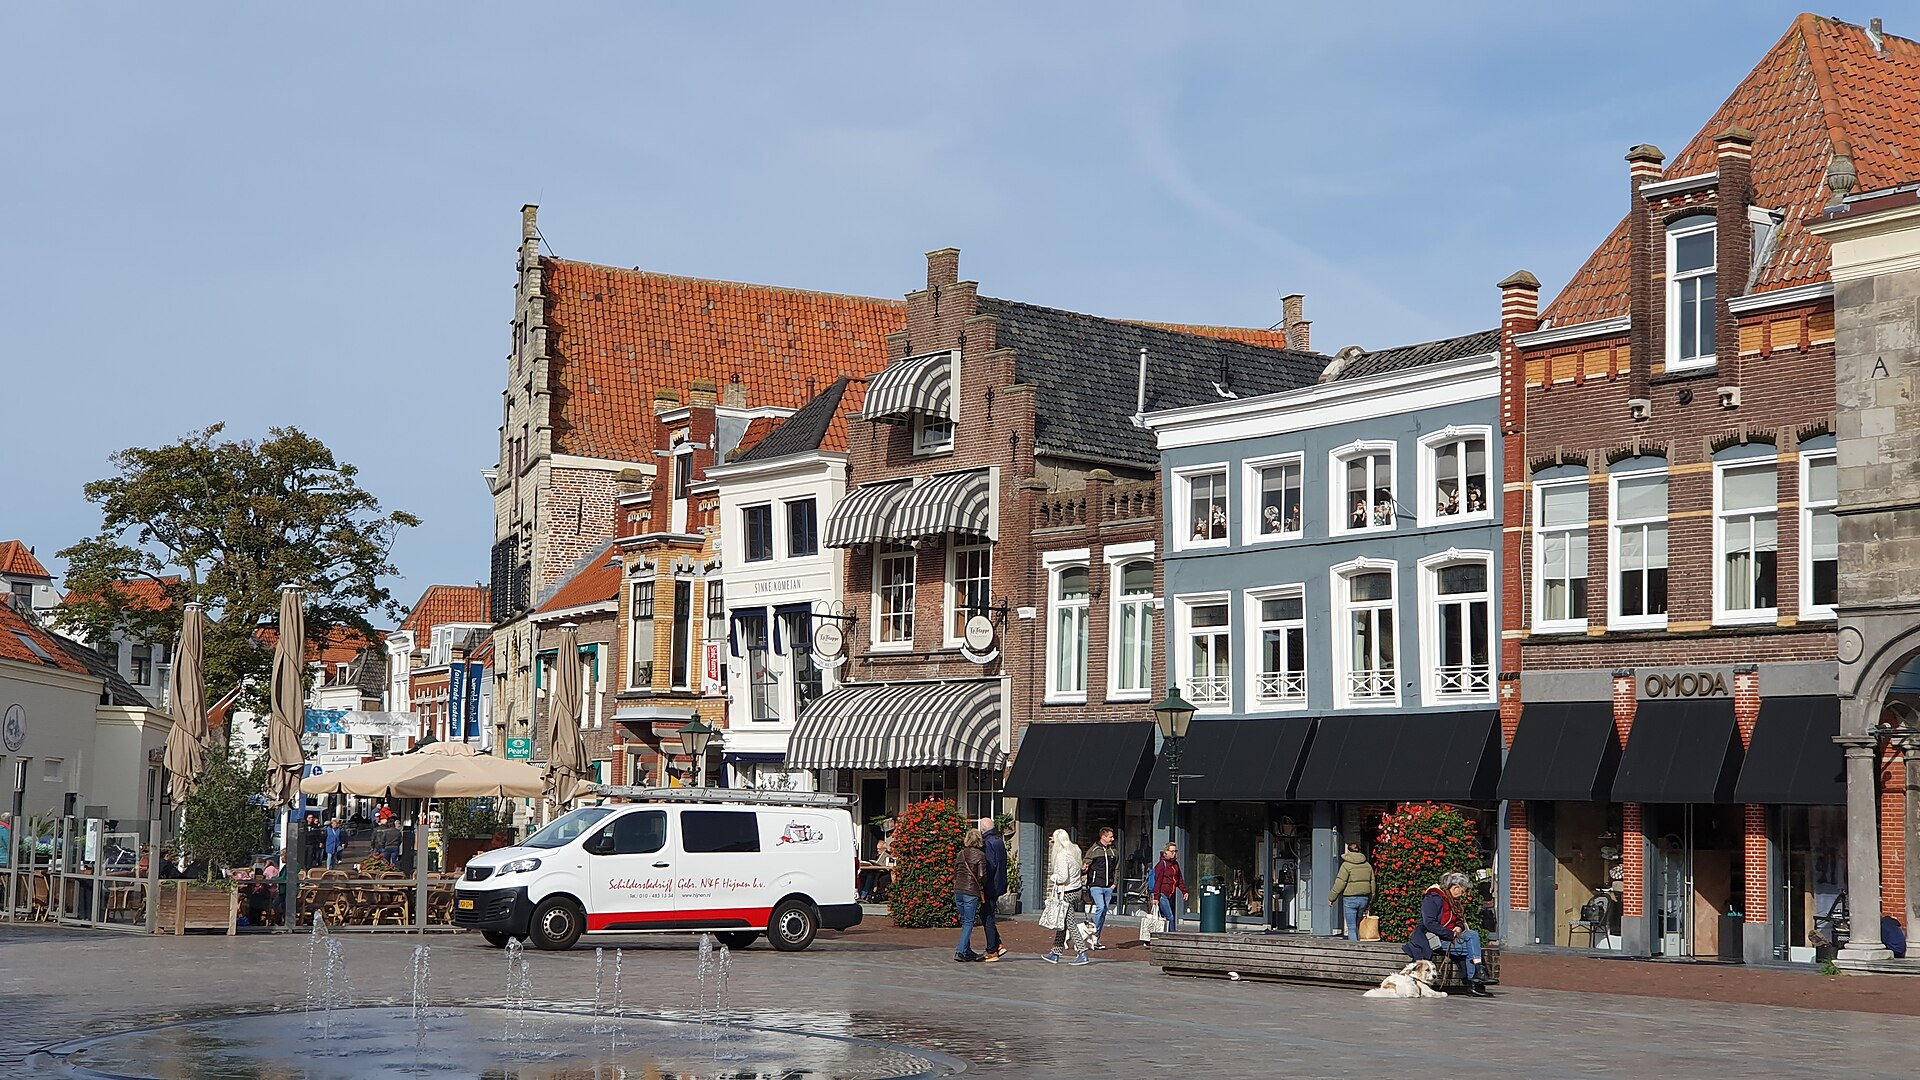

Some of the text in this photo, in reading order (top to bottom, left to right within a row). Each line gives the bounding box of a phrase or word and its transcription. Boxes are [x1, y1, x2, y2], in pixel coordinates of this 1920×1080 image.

[1870, 355, 1890, 378] A
[754, 579, 801, 593] SINKE KOMEJAN
[452, 669, 462, 701] fairtrade
[1645, 671, 1729, 698] OMODA
[508, 747, 529, 755] Pearle
[608, 878, 673, 893] Schildersbedrijf
[677, 878, 697, 890] Gebr.
[722, 877, 751, 892] Hijnen
[752, 877, 766, 889] b.v.
